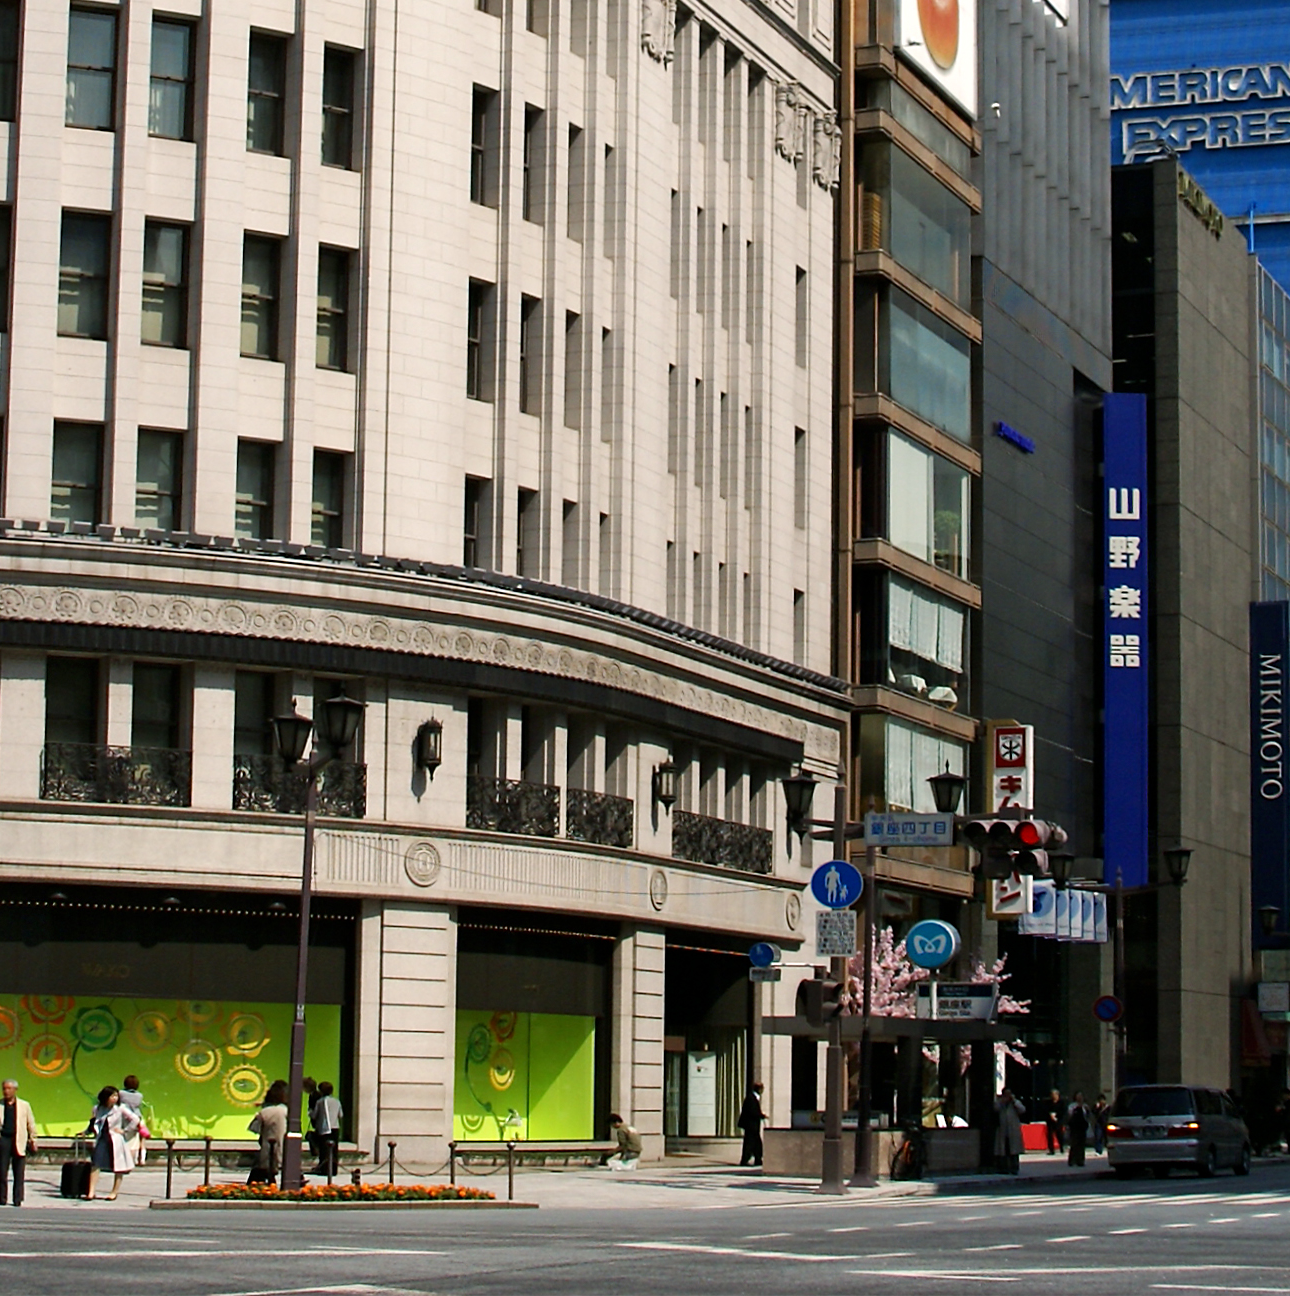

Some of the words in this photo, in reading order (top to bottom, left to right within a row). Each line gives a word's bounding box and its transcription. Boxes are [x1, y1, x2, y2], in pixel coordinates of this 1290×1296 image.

[1108, 487, 1141, 667] 山野楽器
[1260, 653, 1284, 799] MIKIMOTO
[871, 821, 947, 836] 銀座四丁目
